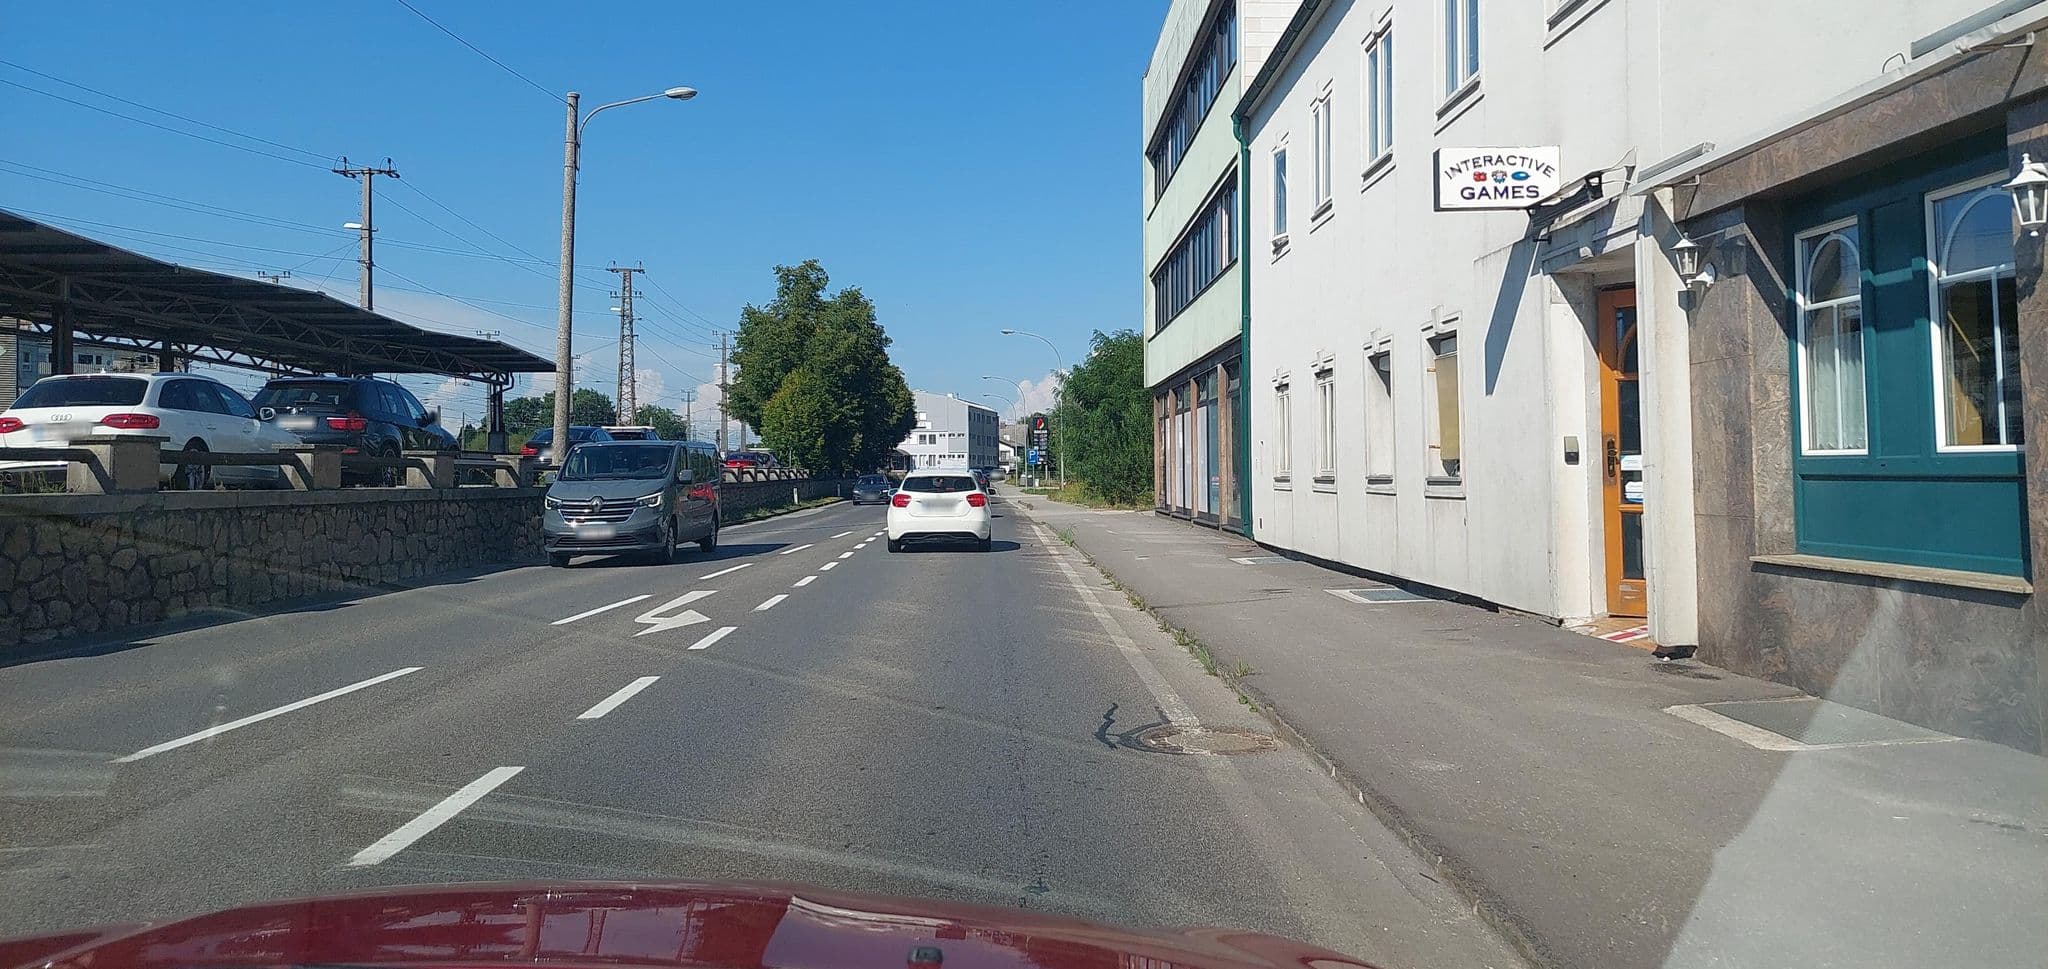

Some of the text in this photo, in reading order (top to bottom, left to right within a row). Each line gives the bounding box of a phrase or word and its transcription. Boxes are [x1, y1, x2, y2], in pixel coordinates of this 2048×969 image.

[1444, 154, 1555, 180] INTERACTIVE
[1460, 185, 1540, 200] GAMES
[1029, 450, 1036, 459] P
